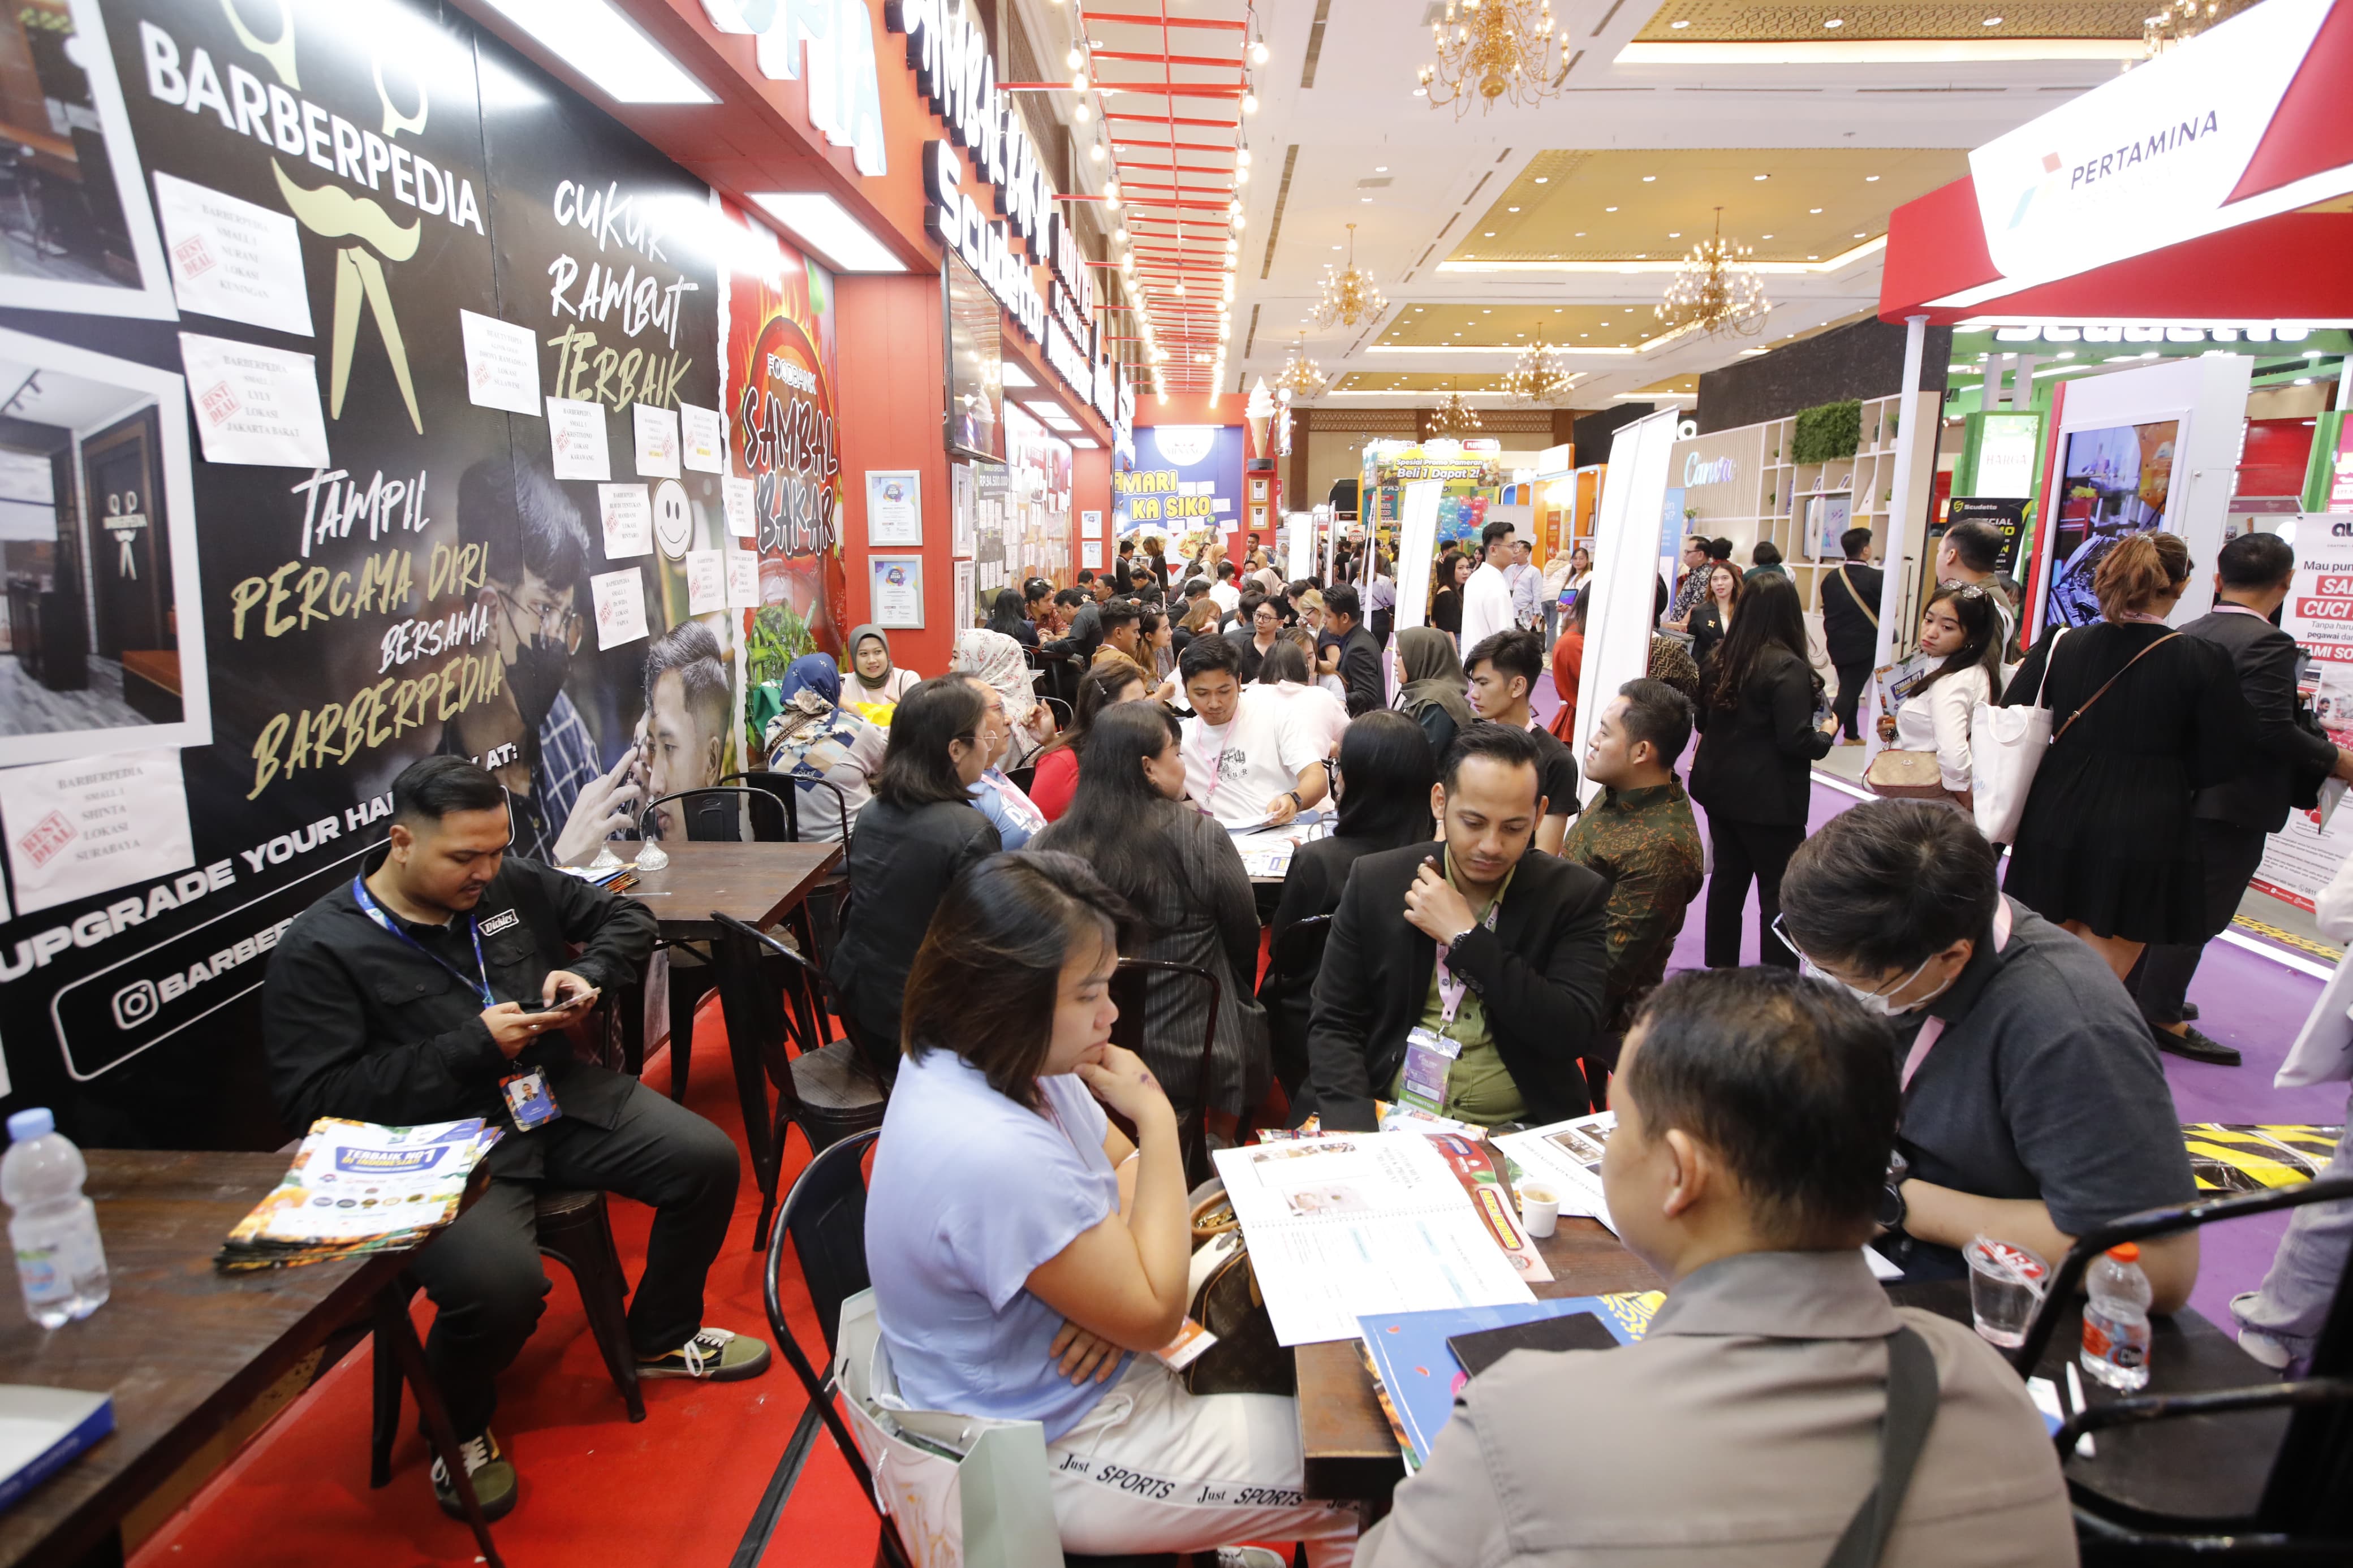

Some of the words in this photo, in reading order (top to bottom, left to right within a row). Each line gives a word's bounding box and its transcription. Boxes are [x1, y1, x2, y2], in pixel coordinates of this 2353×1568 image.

[140, 20, 485, 236] BARBERPEDIA
[2071, 110, 2217, 190] PERTAMINA
[175, 239, 204, 262] BEST
[183, 253, 213, 276] DEAL
[548, 253, 699, 350] RAMBUT
[548, 323, 692, 413] TERBAIK
[767, 352, 817, 395] FOODBANK
[202, 385, 228, 411] BEST
[209, 398, 236, 424] DEAL
[245, 407, 278, 418] LOKASI
[226, 422, 270, 435] JAKARTA
[272, 427, 299, 437] BARAT
[741, 386, 838, 485] SAMBAL
[1396, 459, 1423, 467] Spesial
[1683, 451, 1735, 488] Canva
[1986, 454, 2027, 465] HARGA
[1123, 470, 1178, 495] MARI
[1397, 468, 1422, 478] Beli
[1423, 468, 1427, 478] 1
[1431, 468, 1467, 480] Dapat
[1470, 469, 1481, 478] 2!
[291, 469, 430, 559] TAMPIL
[756, 470, 835, 557] BAKAR
[1131, 498, 1161, 520] KA
[1165, 495, 1212, 519] SIKO
[2304, 560, 2329, 571] Mau
[231, 548, 413, 640] PERCAYA
[428, 541, 489, 602] DIRI
[2303, 601, 2350, 618] CUCI
[2307, 632, 2339, 640] pegawai
[2311, 621, 2334, 630] Tanpa
[378, 602, 489, 675] BERSAMA
[246, 650, 503, 801] BARBERPEDIA
[772, 718, 809, 748] MASHASHIJIA
[485, 741, 519, 772] AT:
[58, 766, 144, 789] BARBERPEDIA
[84, 789, 119, 802] SMALL
[82, 804, 127, 821] SHINTA
[21, 815, 62, 851] BEST
[84, 822, 130, 841] LOKASI
[32, 828, 71, 864] DEAL
[76, 839, 141, 861] SURABAYA
[241, 816, 342, 874] YOUR
[484, 914, 514, 933] Dickies
[1406, 1094, 1436, 1110] EXHIBITOR
[344, 1148, 403, 1161] TERBAIK
[404, 1151, 424, 1161] NO
[1059, 1453, 1091, 1474] Just
[1096, 1465, 1176, 1500] SPORTS
[1197, 1485, 1227, 1504] Just
[1234, 1487, 1304, 1507] SPORTS
